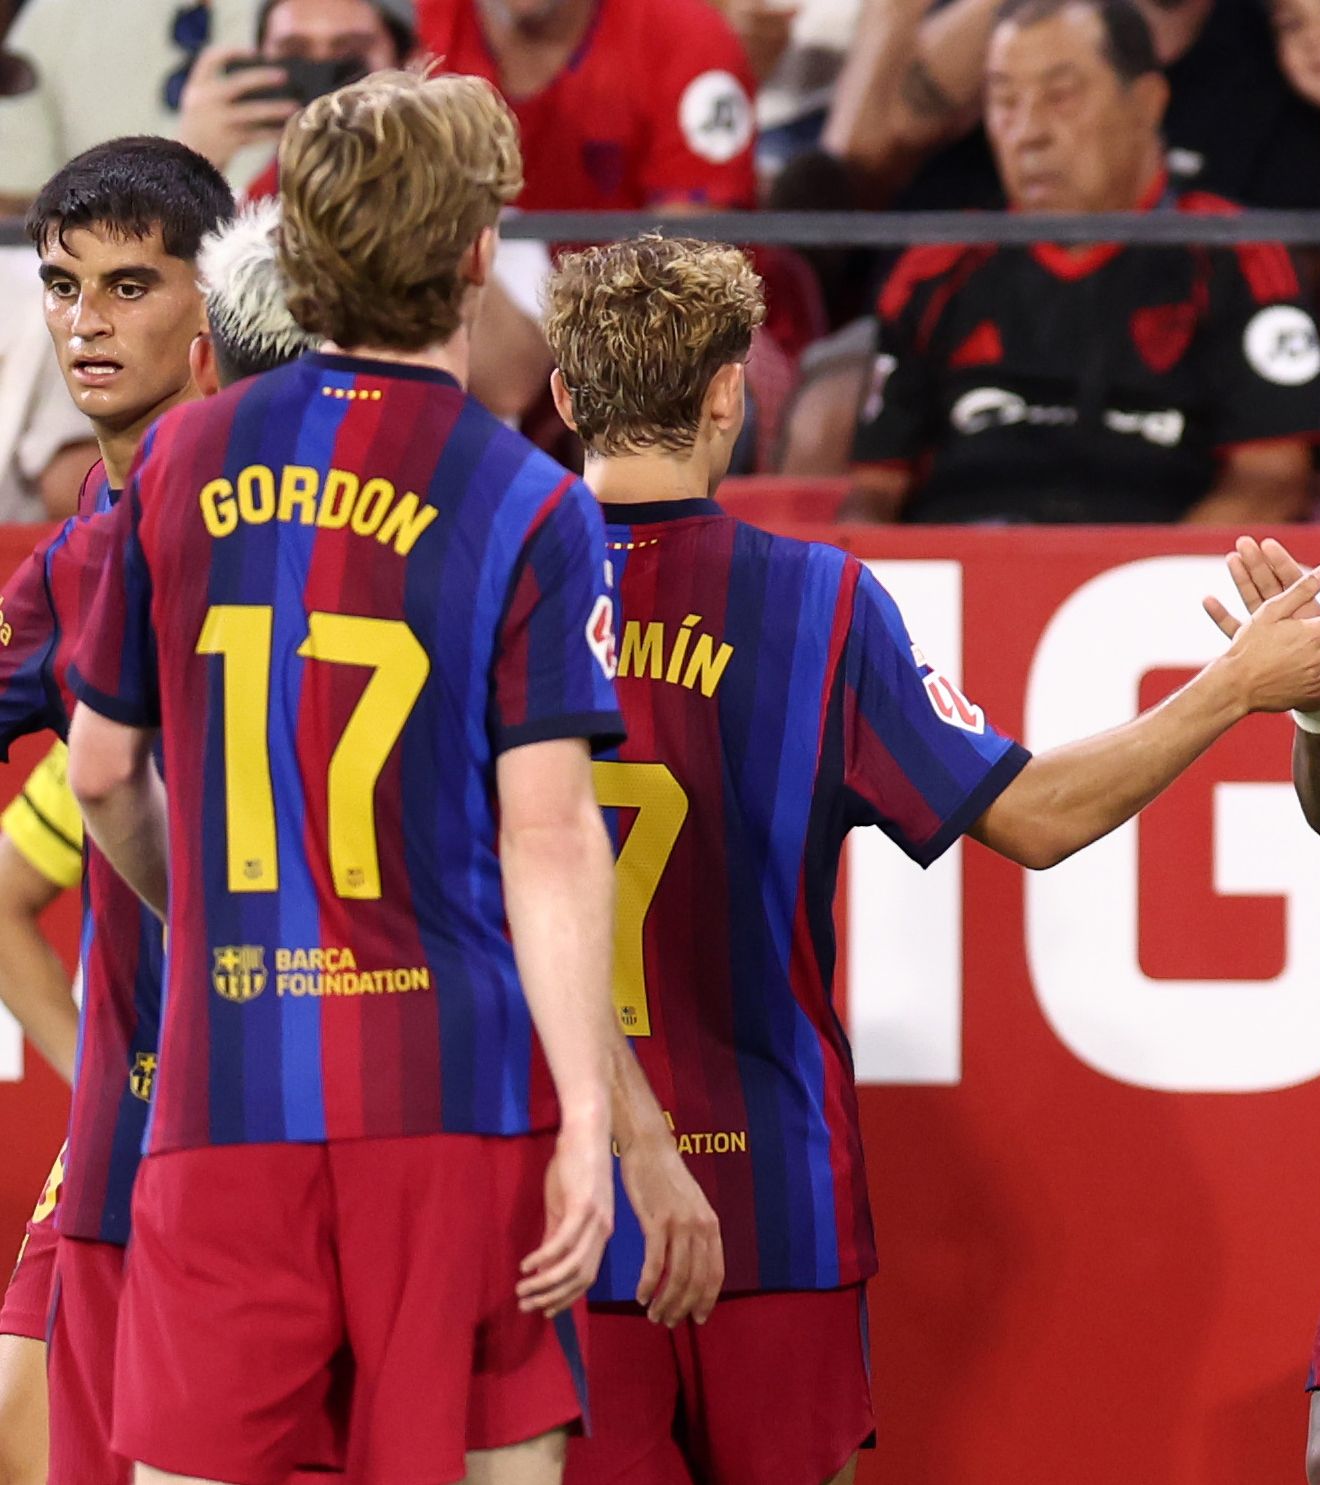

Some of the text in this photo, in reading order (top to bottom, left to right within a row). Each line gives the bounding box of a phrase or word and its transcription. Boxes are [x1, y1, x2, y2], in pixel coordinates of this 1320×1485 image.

[199, 463, 439, 557] GORDON
[617, 613, 735, 699] MÍN
[195, 604, 431, 900] 17
[275, 948, 356, 973] BARÇA
[275, 967, 430, 997] FOUNDATION
[677, 1131, 746, 1154] ATION
